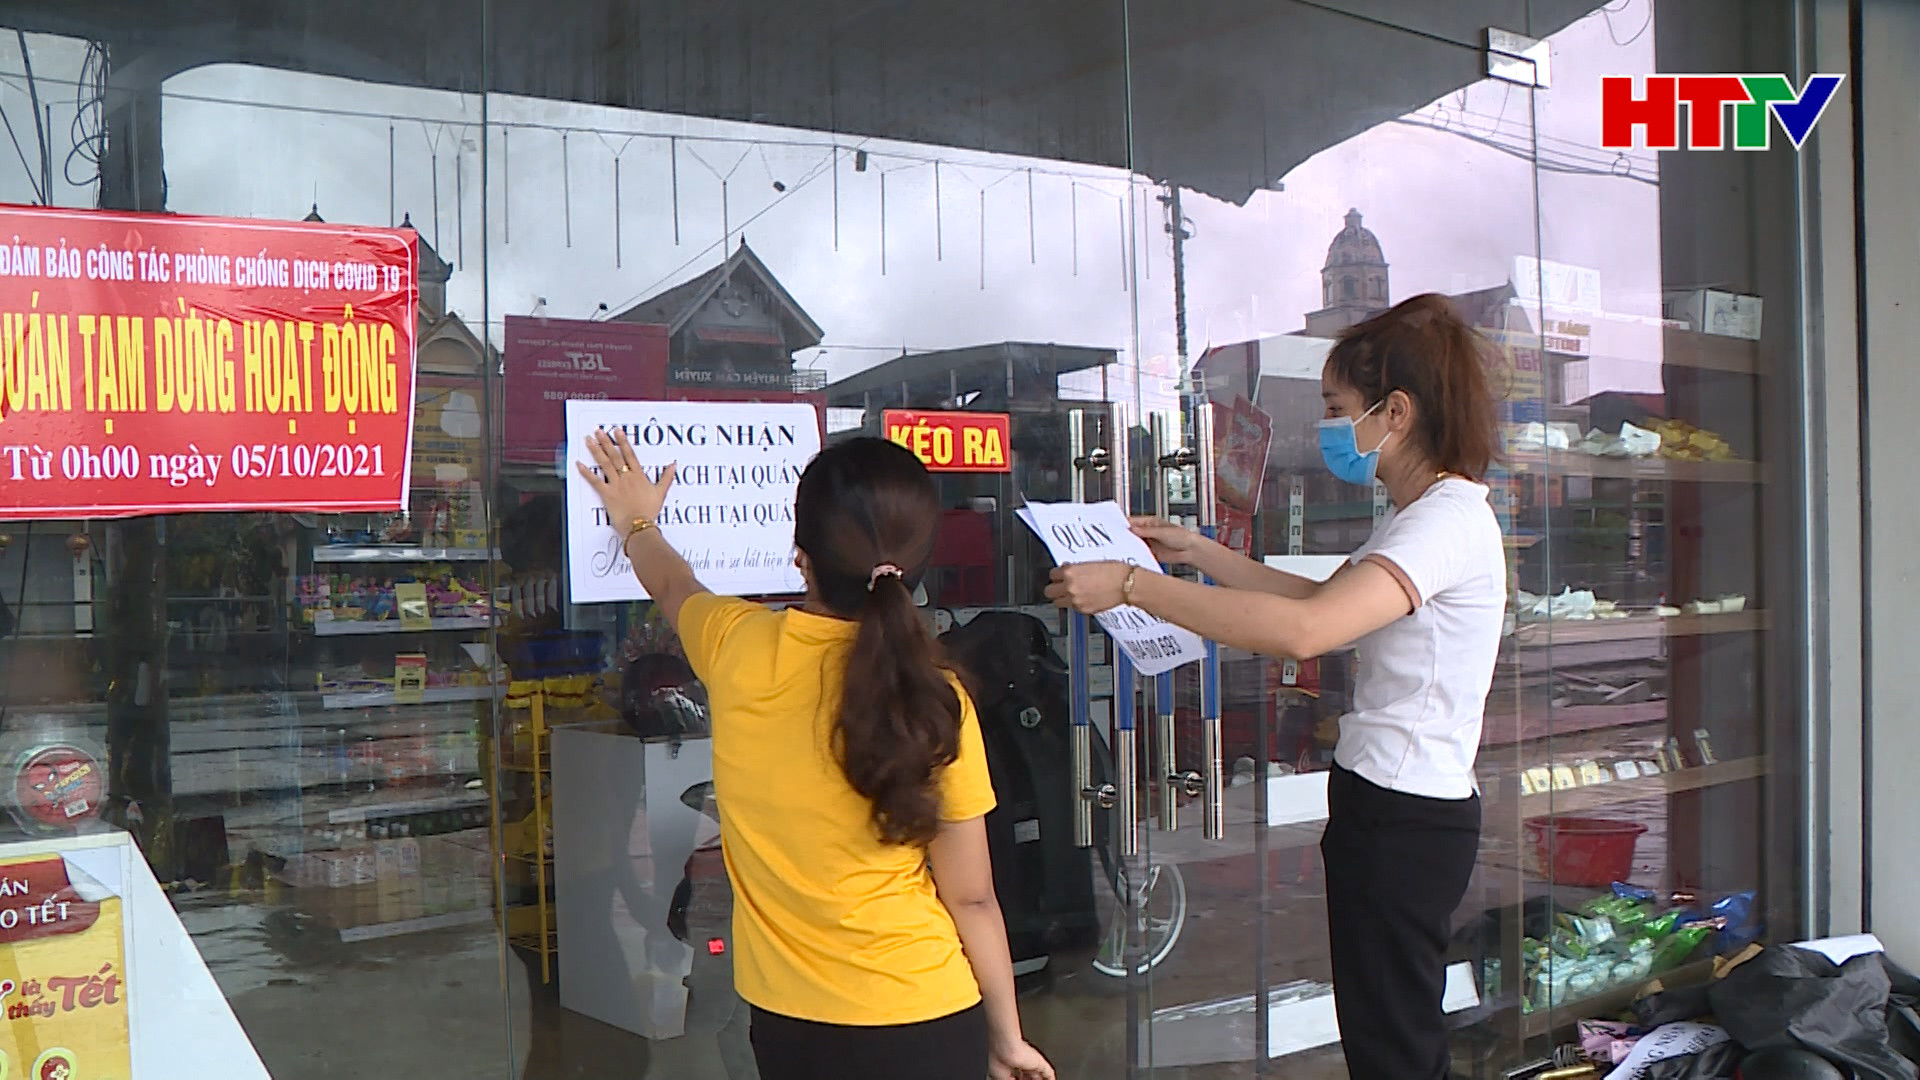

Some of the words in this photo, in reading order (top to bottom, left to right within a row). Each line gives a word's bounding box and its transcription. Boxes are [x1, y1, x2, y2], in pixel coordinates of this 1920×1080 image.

[0, 235, 40, 276] ĐẢM
[45, 237, 81, 278] BẢO
[87, 243, 134, 281] CÔNG
[138, 246, 170, 282] TÁC
[174, 247, 231, 285] PHÒNG
[235, 248, 289, 288] CHỐNG
[293, 258, 329, 294] DỊCH
[334, 261, 377, 292] COVID
[382, 265, 400, 292] 19
[78, 315, 146, 434] TẠM
[154, 297, 236, 413] DỪNG
[243, 319, 314, 434] HOẠT
[322, 303, 398, 434] ĐỘNG
[716, 420, 795, 452] NHẬN
[890, 418, 953, 465] KÉO
[963, 426, 1005, 465] RA
[3, 444, 53, 480] Từ
[61, 445, 140, 480] 0h00
[149, 443, 223, 487] ngày
[231, 443, 386, 478] 05/10/2021
[714, 465, 746, 490] TẠI
[752, 458, 804, 490] QUÁN
[656, 499, 711, 526] HÁCH
[715, 505, 748, 528] TẠI
[753, 498, 796, 528] QUÁ
[1051, 516, 1114, 554] QUÁN
[25, 893, 71, 925] TẾT
[21, 978, 41, 998] là
[47, 962, 122, 1012] Tết
